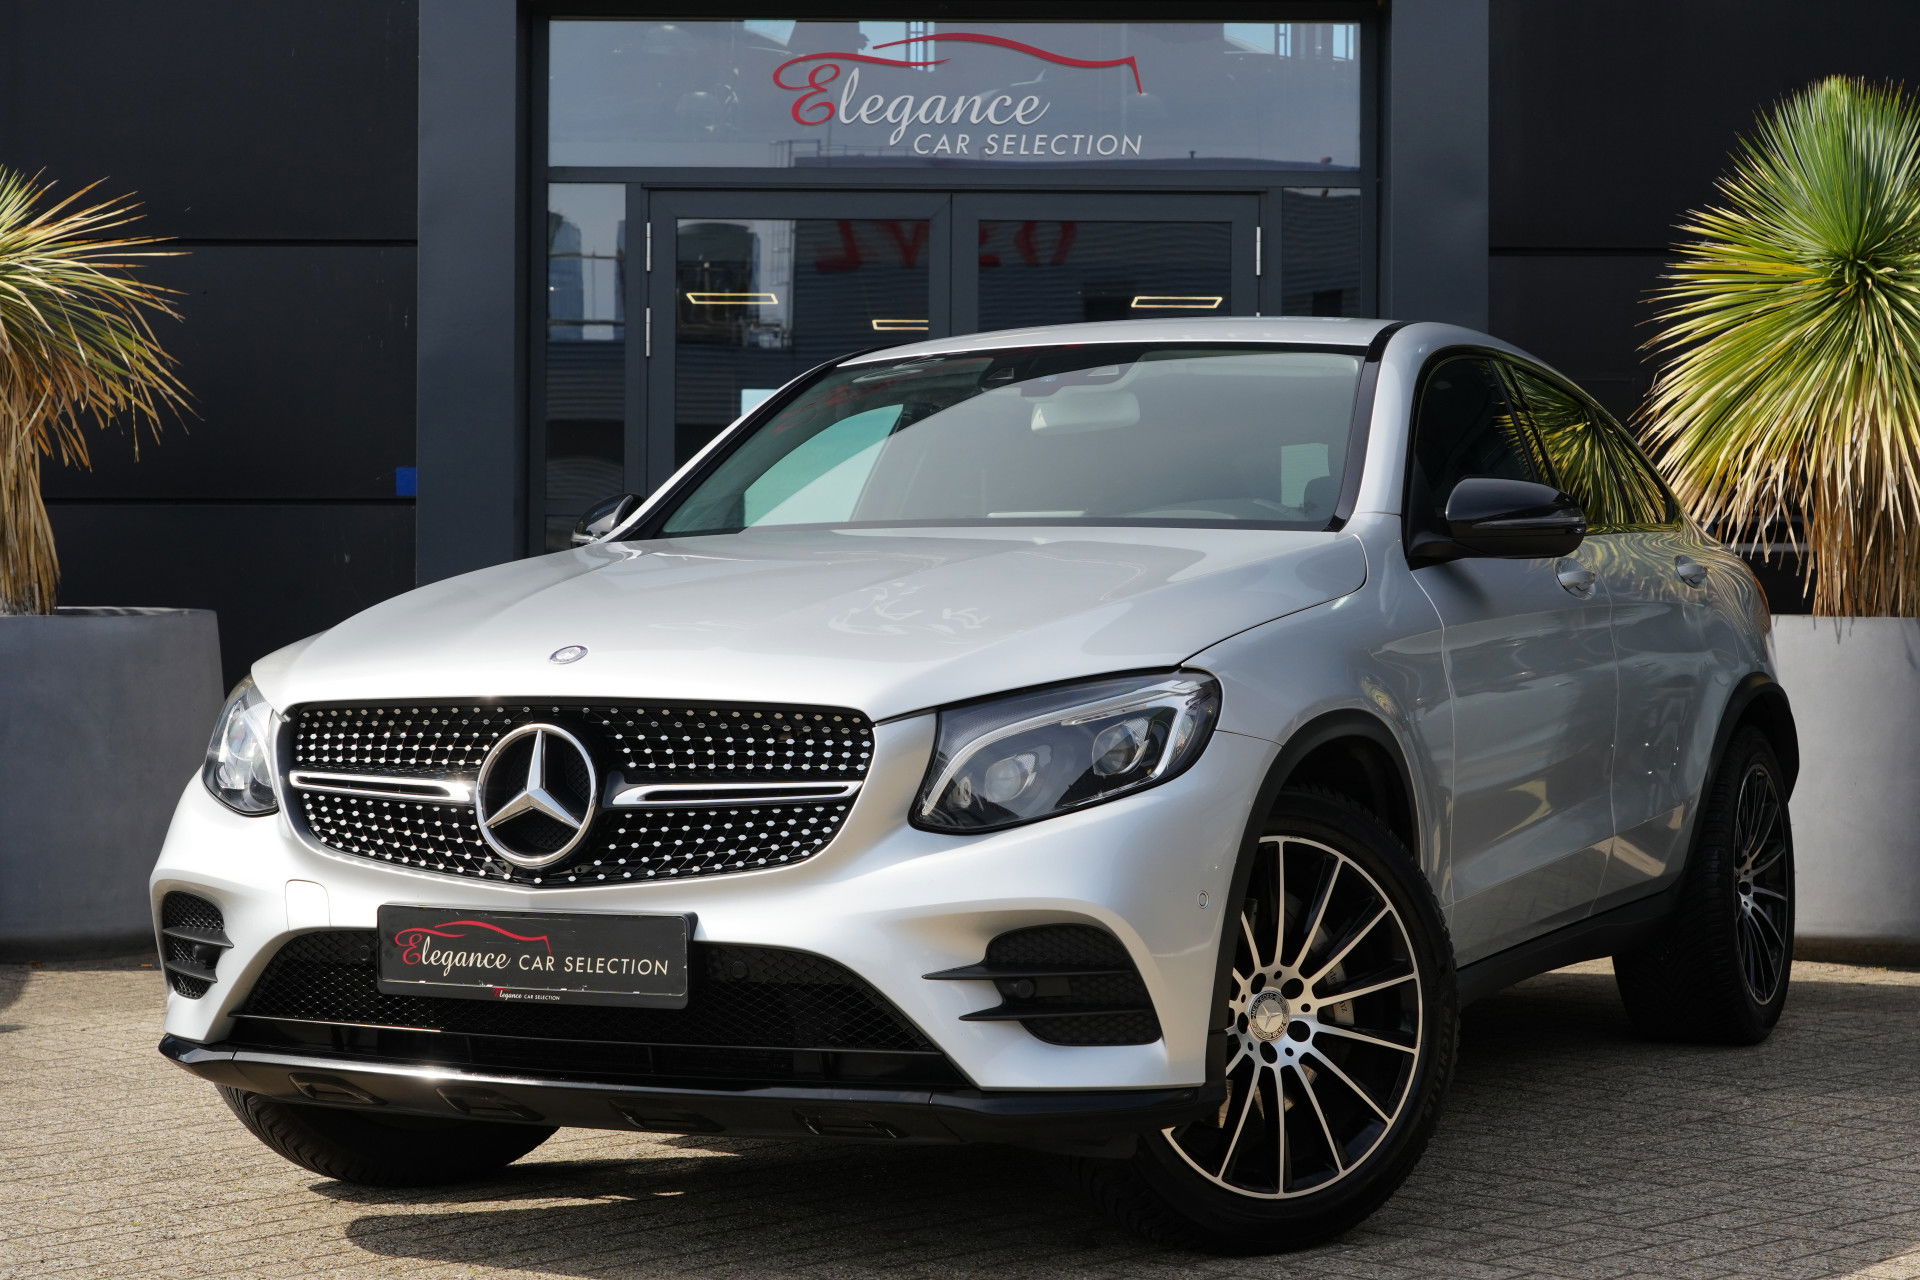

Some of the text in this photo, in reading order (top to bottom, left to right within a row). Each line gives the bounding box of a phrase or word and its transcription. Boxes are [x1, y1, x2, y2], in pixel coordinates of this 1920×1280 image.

[773, 52, 1050, 146] Elegance
[914, 134, 1143, 156] CAR SELECTION
[395, 928, 669, 976] Elegance CAR SELECTION
